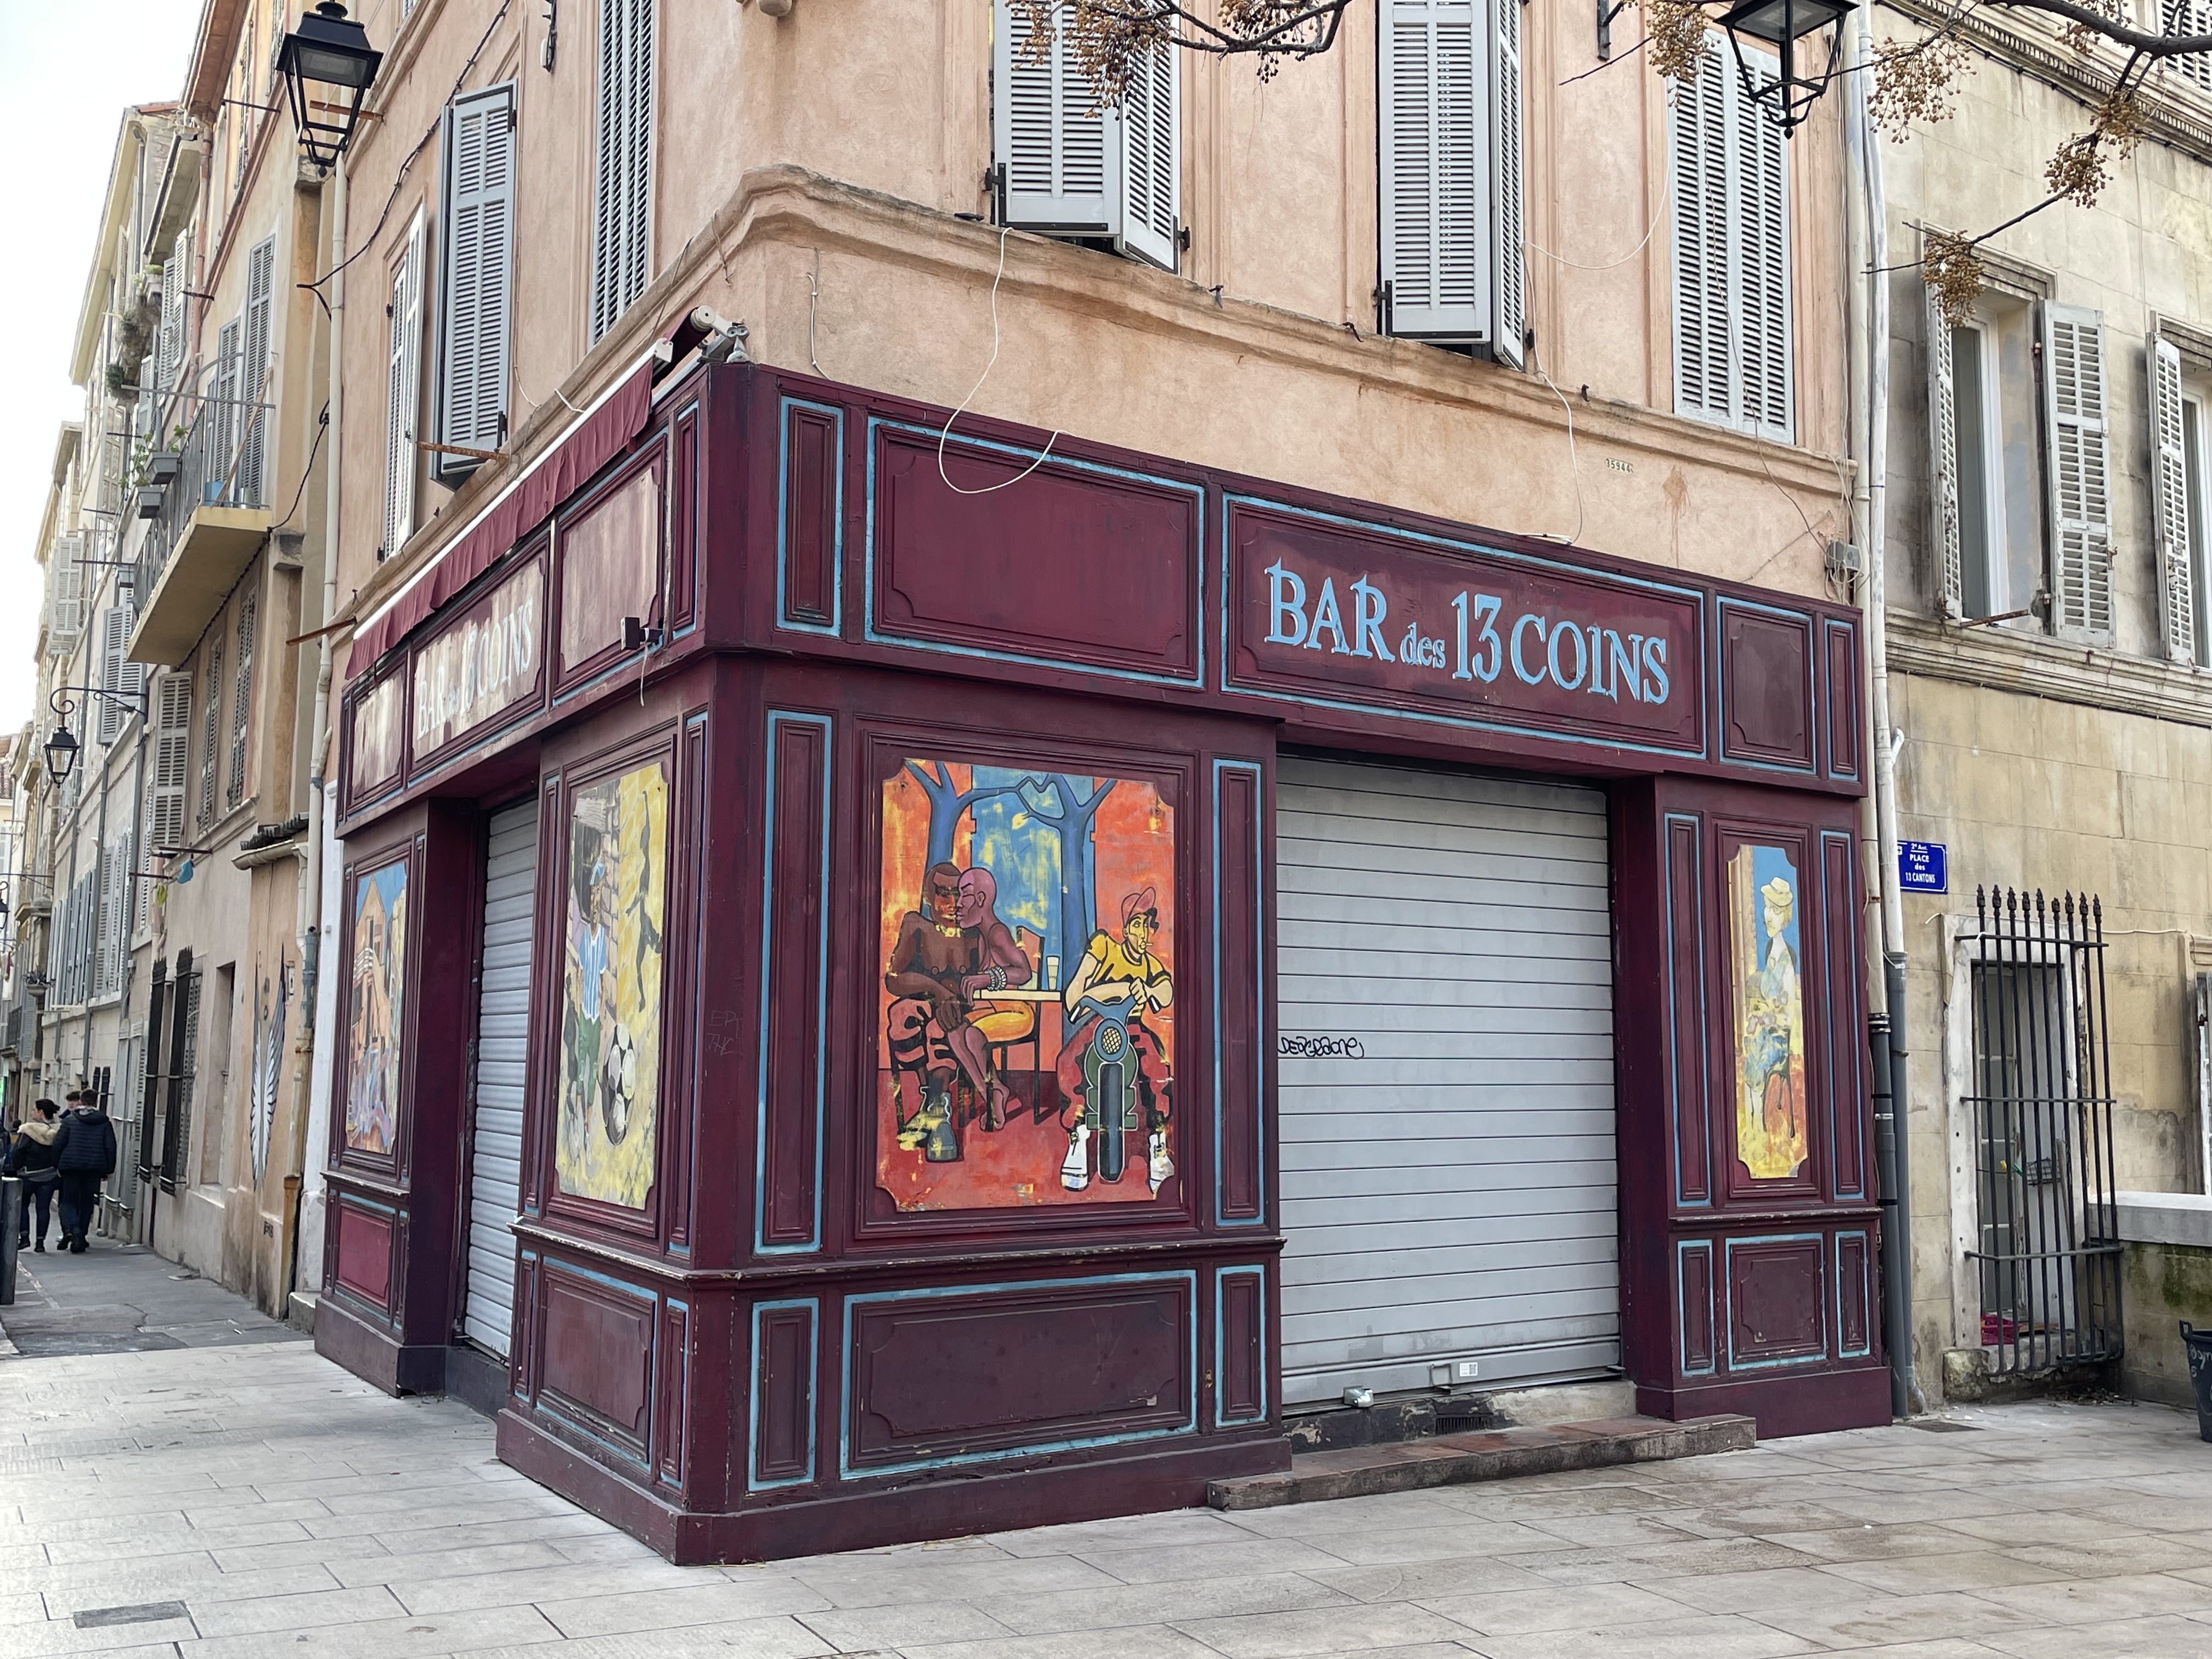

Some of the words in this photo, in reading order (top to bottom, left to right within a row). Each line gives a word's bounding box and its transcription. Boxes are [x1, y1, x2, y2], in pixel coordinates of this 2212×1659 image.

[1606, 458, 1630, 473] 35944
[1264, 557, 1396, 663] BAR
[1400, 622, 1446, 669] des
[1451, 590, 1503, 683] 13
[1510, 613, 1669, 706] COINS
[417, 665, 446, 741] BAR
[477, 596, 533, 699] COINS
[1910, 854, 1929, 862] PLACE
[1914, 862, 1926, 871] des
[1905, 872, 1912, 882] 13
[1912, 872, 1936, 883] CANTONS
